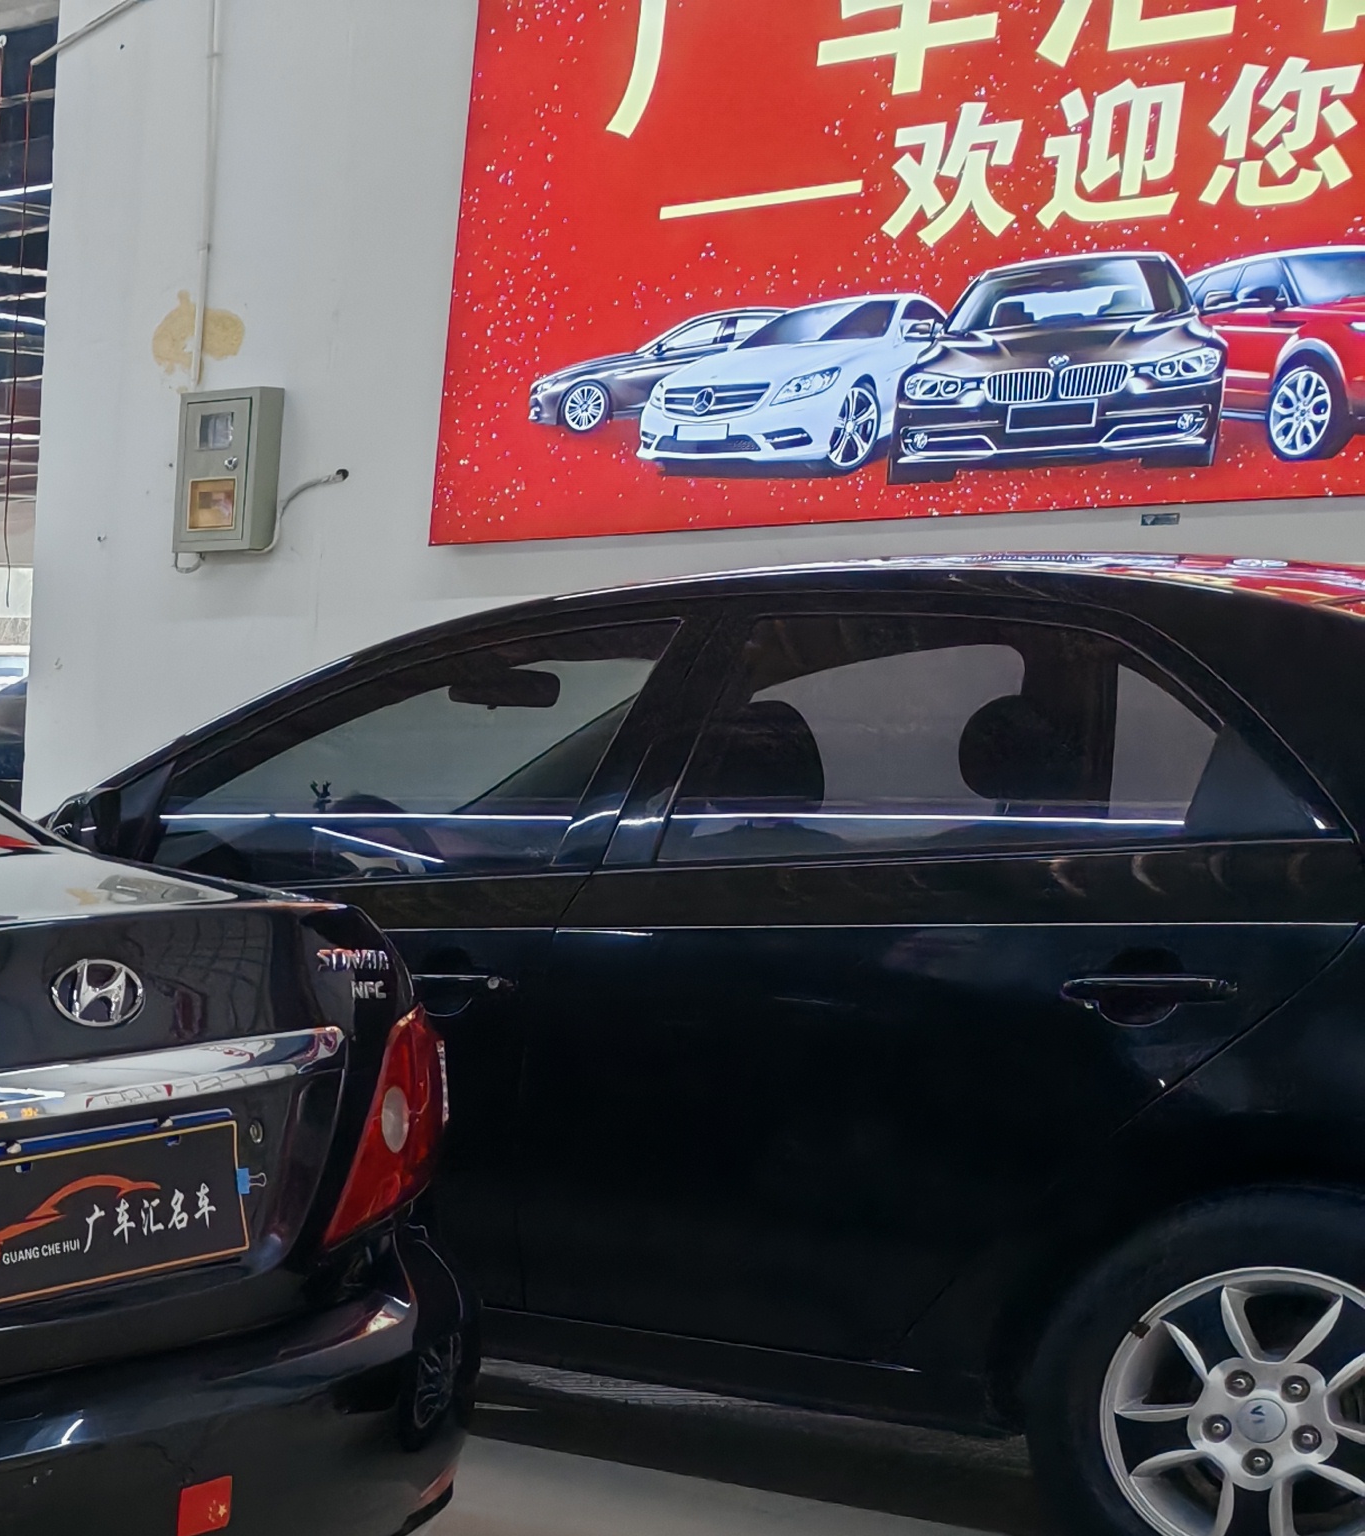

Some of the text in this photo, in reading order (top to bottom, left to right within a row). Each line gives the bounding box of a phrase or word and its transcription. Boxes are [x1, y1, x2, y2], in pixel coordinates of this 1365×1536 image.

[83, 1182, 217, 1254] 广车汇名车
[2, 1238, 81, 1265] GUANG CHE HUI
